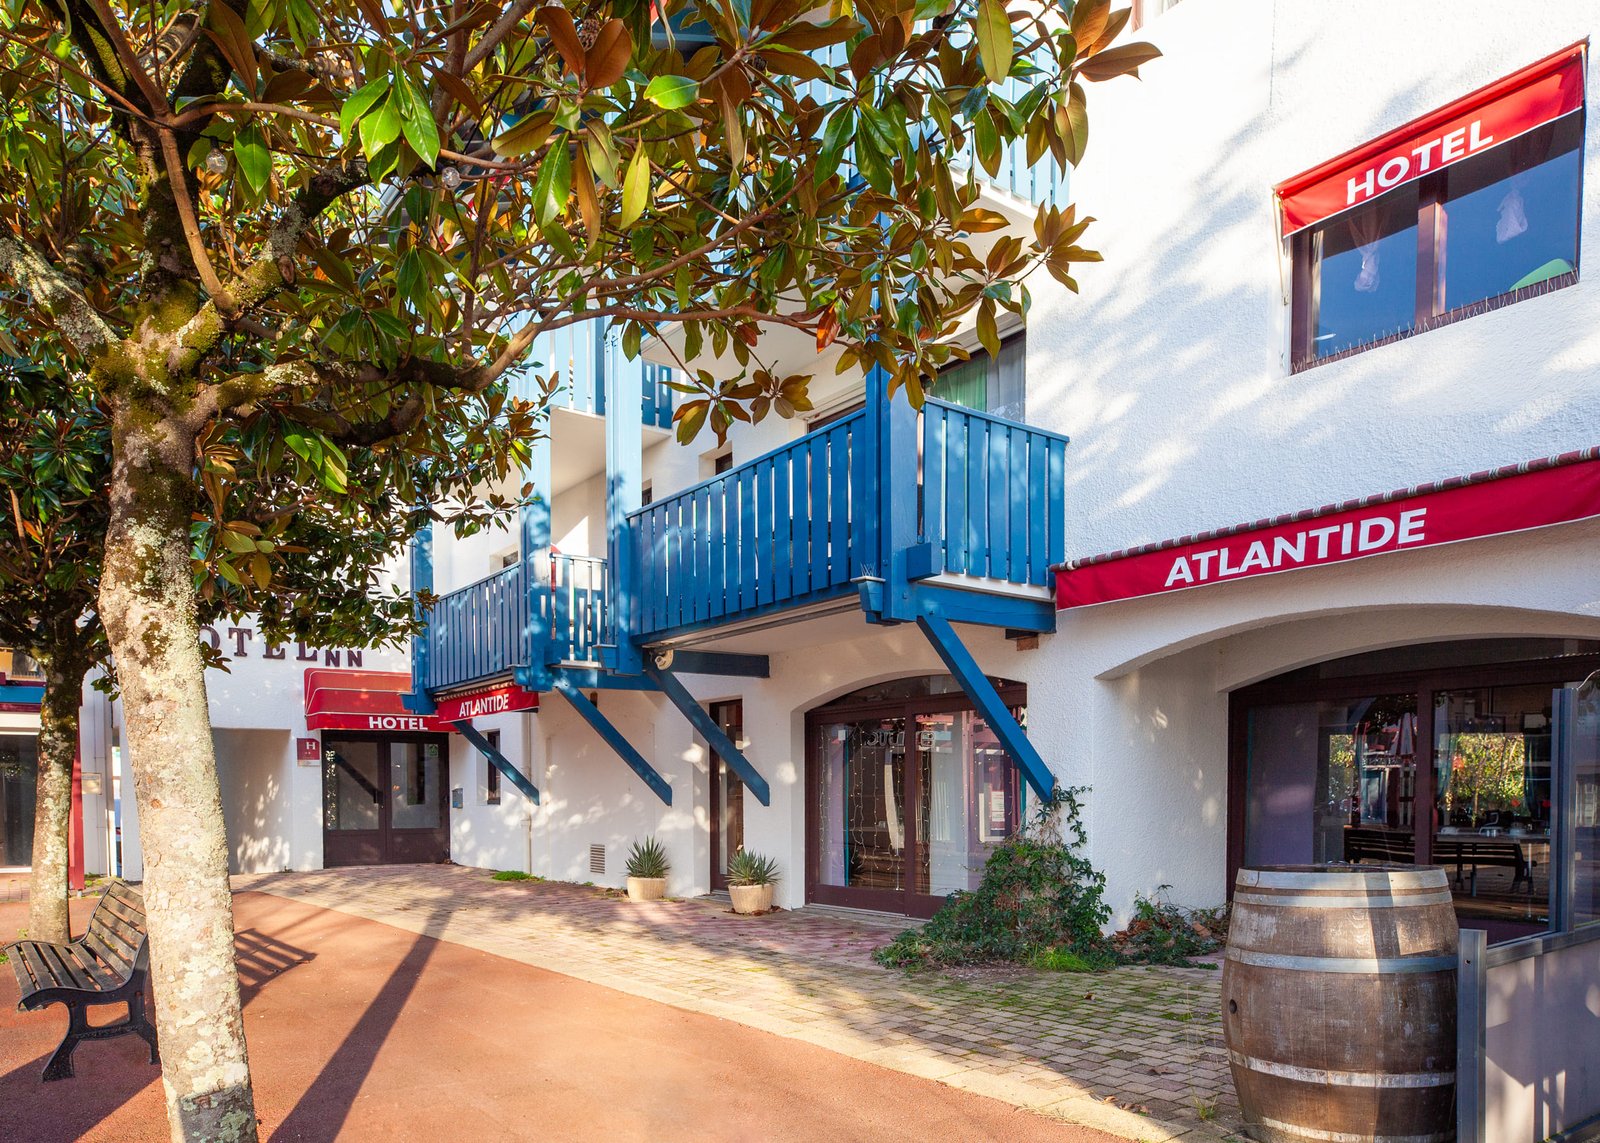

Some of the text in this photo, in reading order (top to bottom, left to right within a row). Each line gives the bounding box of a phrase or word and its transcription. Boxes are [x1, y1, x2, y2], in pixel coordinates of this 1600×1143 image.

[1347, 120, 1494, 205] HOTEL
[1164, 508, 1427, 587] ATLANTIDE
[325, 649, 363, 668] NN
[460, 693, 510, 718] ATLANTIDE
[368, 715, 428, 732] HOTEL
[305, 741, 316, 750] H
